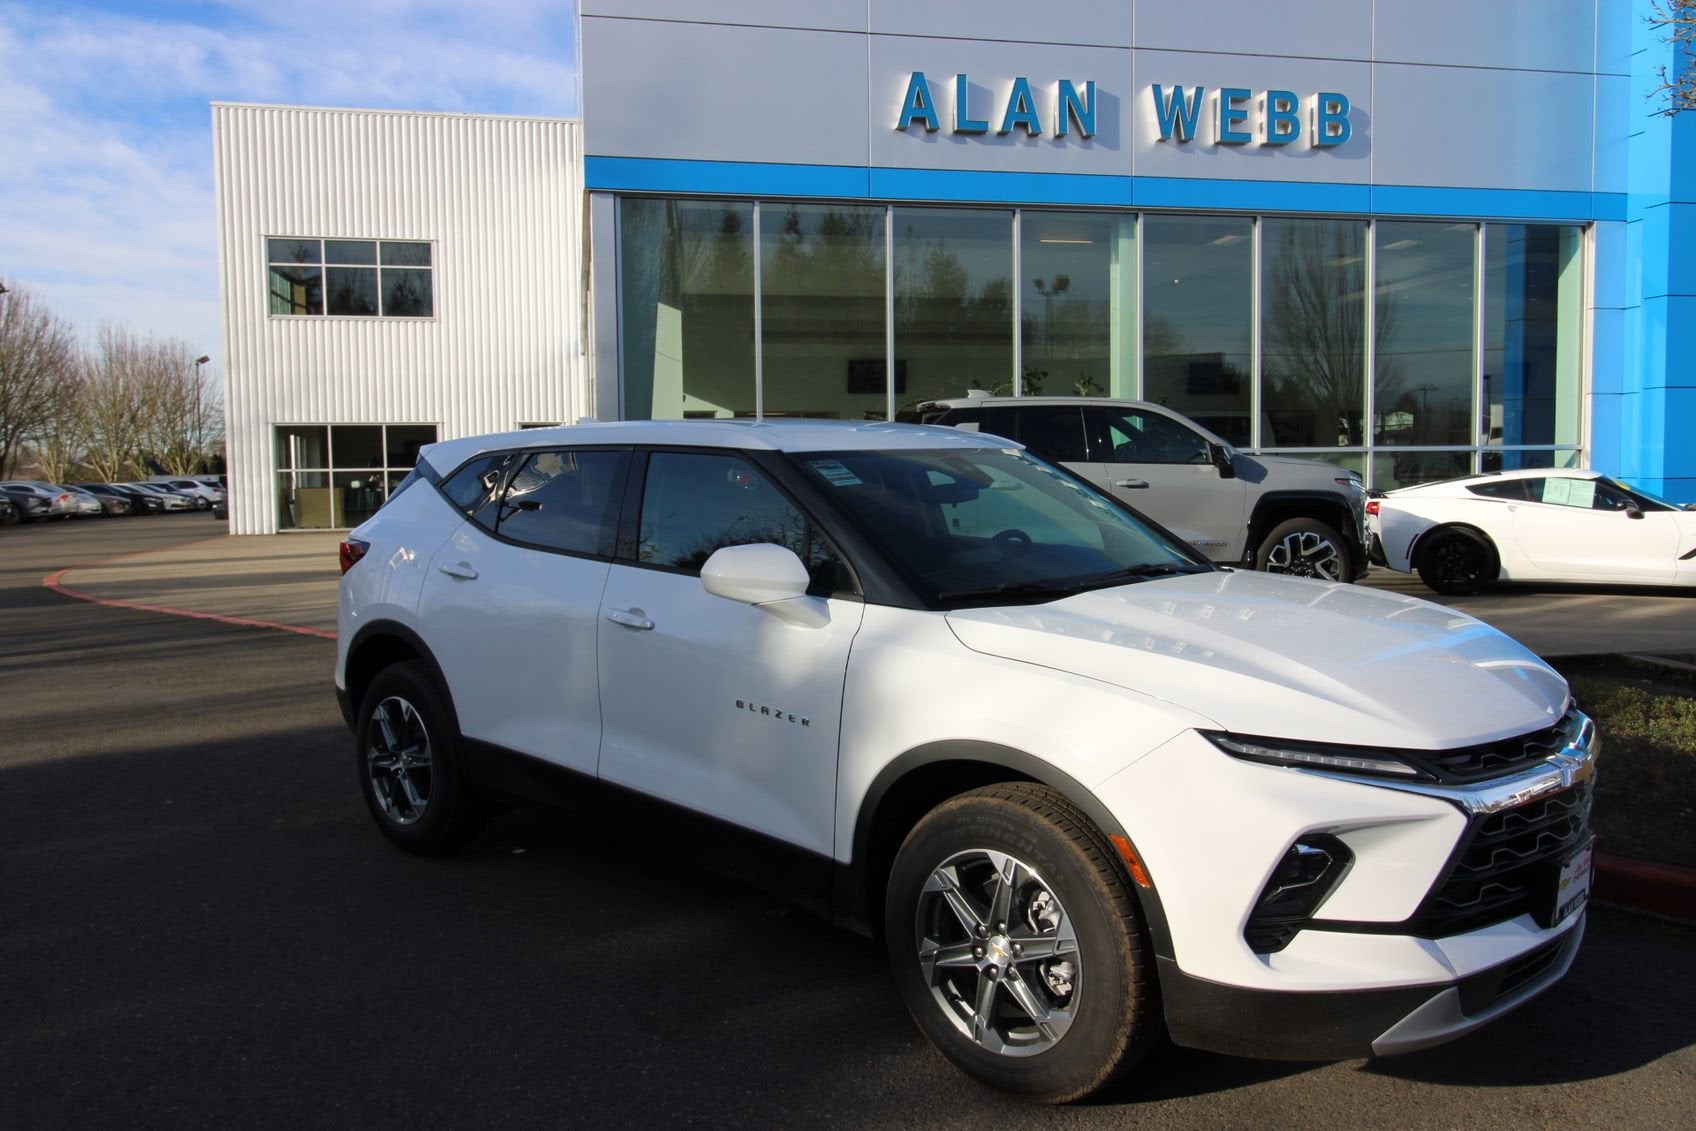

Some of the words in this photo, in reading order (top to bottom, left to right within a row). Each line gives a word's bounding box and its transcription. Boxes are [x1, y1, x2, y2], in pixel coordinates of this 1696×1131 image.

[896, 71, 1097, 137] ALAN
[1152, 84, 1352, 147] WEBB
[736, 700, 810, 727] BLAZER
